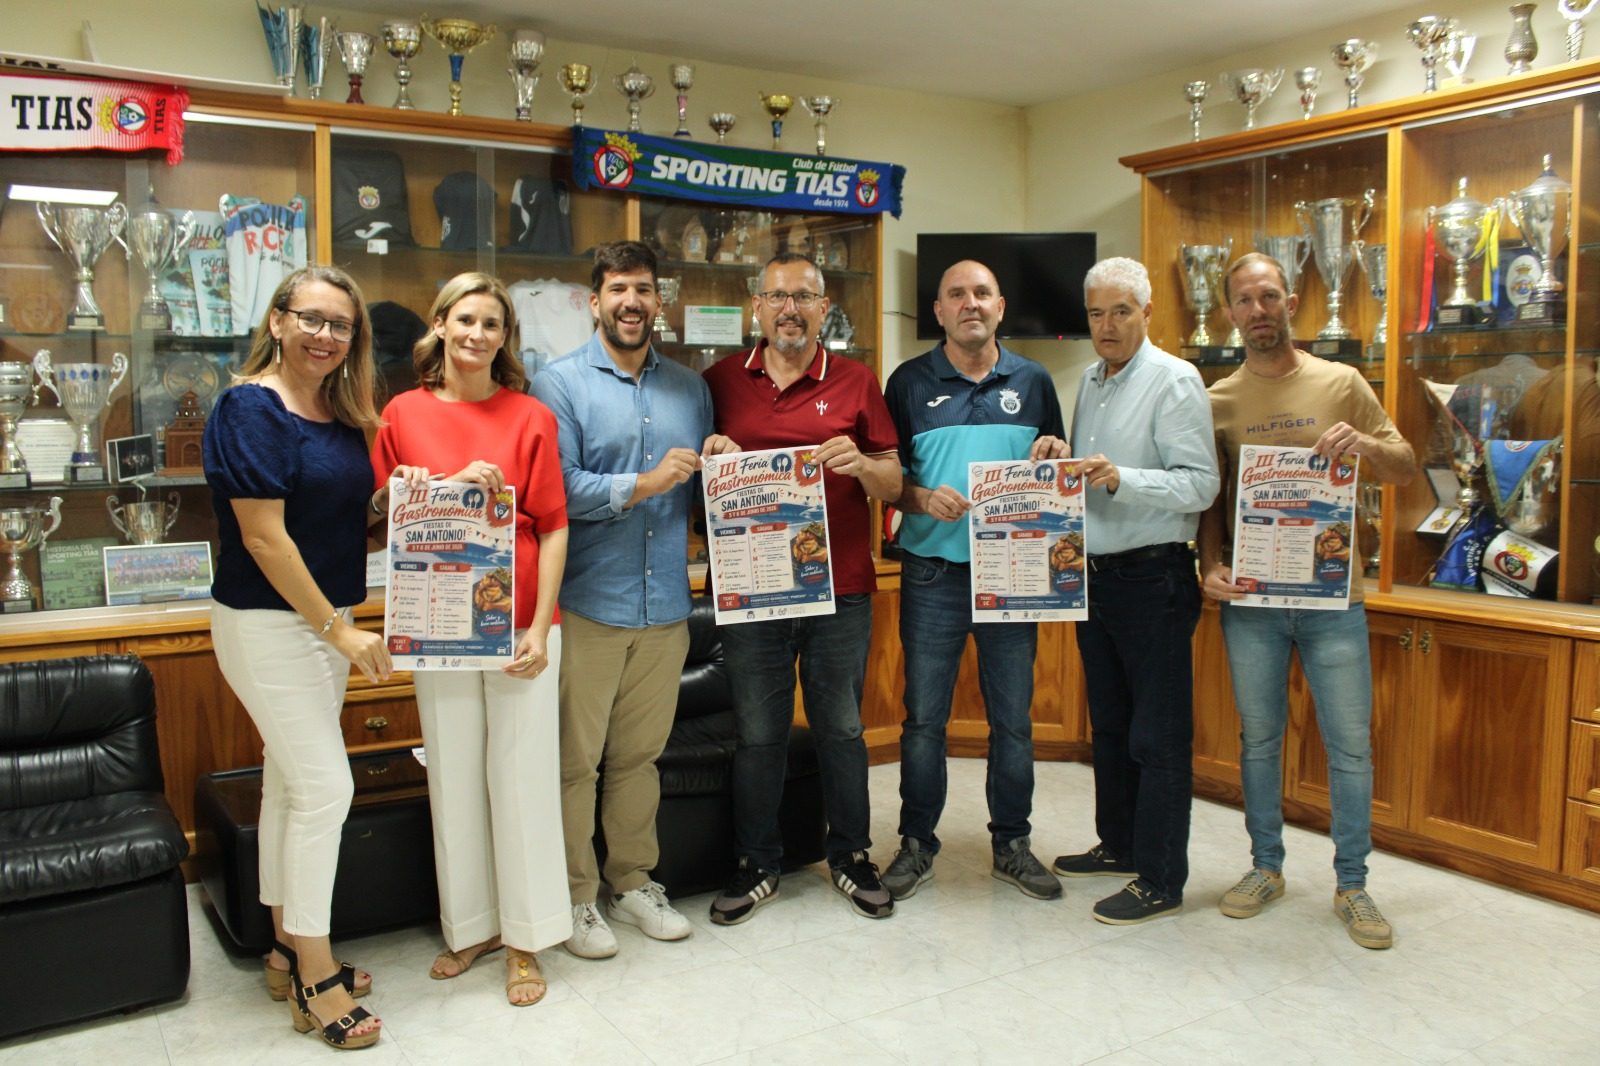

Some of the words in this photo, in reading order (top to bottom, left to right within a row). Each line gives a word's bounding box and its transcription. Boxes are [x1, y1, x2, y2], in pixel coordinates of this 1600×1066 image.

[12, 95, 93, 131] TIAS
[154, 98, 166, 134] TIAS
[792, 158, 814, 168] Club
[814, 160, 826, 171] de
[651, 154, 787, 193] SPORTING
[795, 172, 850, 198] TIAS
[813, 198, 832, 208] desde
[834, 199, 848, 208] 1974
[1246, 417, 1317, 434] HILFIGER
[719, 462, 737, 478] III
[740, 456, 769, 474] Feria
[1255, 454, 1275, 468] III
[1277, 452, 1306, 467] Feria
[984, 468, 1002, 484] III
[1004, 464, 1032, 482] Feria
[1242, 467, 1327, 485] Gastronómica
[707, 470, 792, 498] Gastronómica
[736, 488, 756, 498] FIESTAS
[972, 479, 1054, 502] Gastronómica
[407, 489, 428, 505] III
[431, 486, 460, 504] Feria
[721, 500, 738, 512] SAN
[740, 492, 778, 508] ANTONIO!
[1252, 490, 1269, 500] SAN
[1271, 489, 1311, 500] ANTONIO!
[392, 503, 483, 525] Gastronómica
[984, 506, 1000, 516] SAN
[1002, 500, 1040, 514] ANTONIO!
[405, 530, 424, 543] SAN
[426, 529, 466, 542] ANTONIO!
[48, 551, 82, 559] SPORTING
